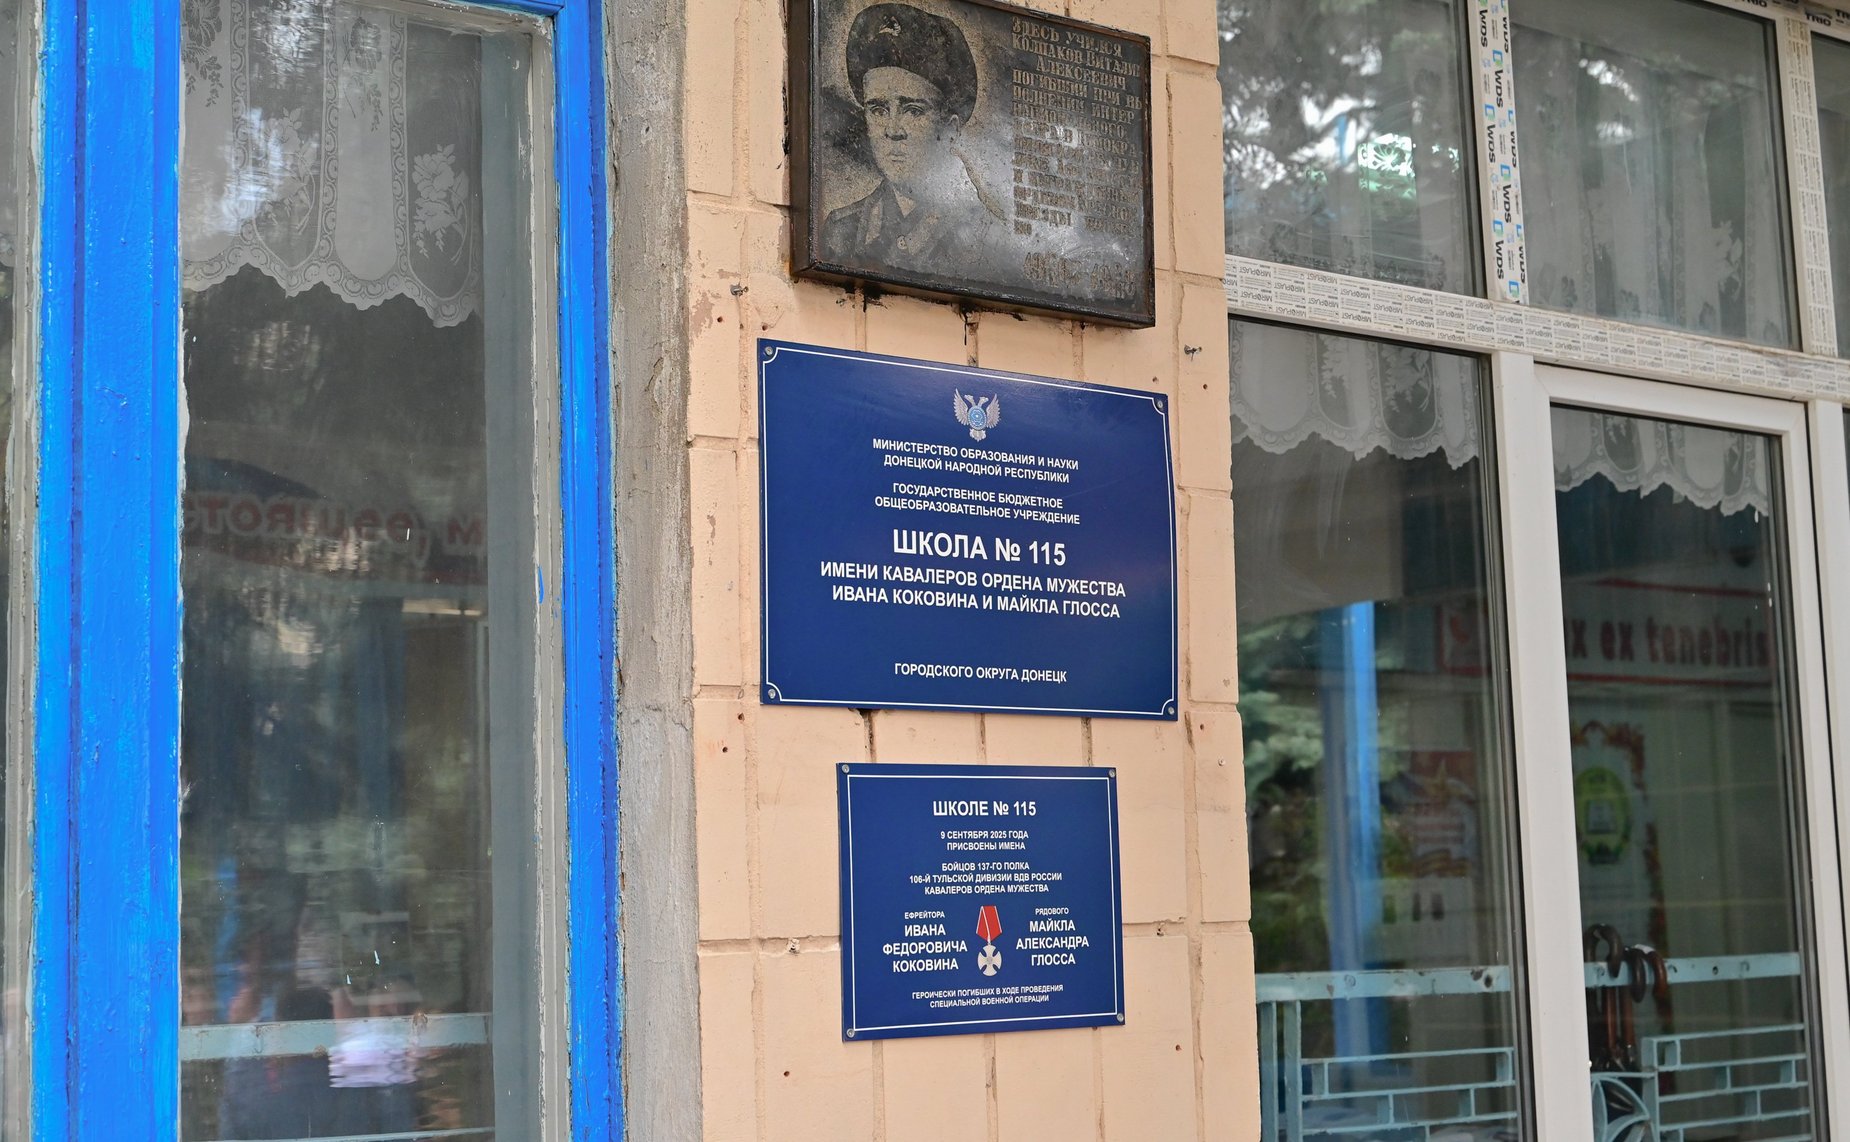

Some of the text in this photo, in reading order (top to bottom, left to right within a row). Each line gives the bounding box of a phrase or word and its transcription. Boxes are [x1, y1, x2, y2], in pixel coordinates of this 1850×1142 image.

[1479, 10, 1488, 48] WDS
[1495, 69, 1503, 108] WDS
[1487, 124, 1495, 163] WDS
[1503, 185, 1511, 223] WDS
[1495, 241, 1504, 280] WDS
[873, 438, 1078, 470] МИНИСТЕРСТВО ОБРАЗОВАНИЯ И НАУКИ
[884, 455, 1069, 483] ДОНЕЦКОЙ НАРОДНОЙ РЕСПУБЛИКИ
[893, 483, 1063, 508] ГОСУДАРСТВЕННОЕ БЮДЖЕТНОЕ
[875, 496, 1080, 524] ОБЩЕОБРАЗОВАТЕЛЬНОЕ УЧРЕЖДЕНИЕ
[894, 529, 1066, 566] ШКОЛА № 115
[821, 561, 1126, 597] ИМЕНИ КАВАЛЕРОВ ОРДЕНА МУЖЕСТВА
[833, 585, 1120, 618] ИВАНА КОКОВИНА И МАЙКЛА ГЛОССА
[895, 663, 1067, 684] ГОРОДСКОГО ОКРУГА ДОНЕЦК
[933, 801, 1036, 816] ШКОЛЕ № 115
[941, 830, 1029, 840] 9 СЕНТЯБРЯ 2025 ГОДА
[947, 842, 1025, 850] ПРИСВОЕНЫ ИМЕНА
[942, 861, 1030, 872] БОЙЦОВ 137-ГО ПОЛКА
[910, 873, 1062, 883] 106-Й ТУЛЬСКОЙ ДИВИЗИИ ВДВ РОССИИ
[925, 884, 1049, 895] КАВАЛЕРОВ ОРДЕНА МУЖЕСТВА
[905, 910, 945, 919] ЕФРЕЙТОРА
[1035, 907, 1069, 916] РЯДОВОГО
[905, 924, 946, 937] ИВАНА
[1030, 918, 1075, 932] МАЙКЛА
[883, 940, 968, 957] ФЕДОРОВИЧА
[1016, 936, 1089, 950] АЛЕКСАНДРА
[893, 958, 959, 972] КОКОВИНА
[1031, 953, 1076, 966] ГЛОССА
[912, 990, 956, 999] ГЕРОИЧЕСКИ
[957, 988, 995, 997] ПОГИБШИХ
[1002, 987, 1019, 995] ХОДЕ
[1021, 984, 1063, 993] ПРОВЕДЕНИЯ
[930, 995, 1049, 1008] СПЕЦИАЛЬНОЙ ВОЕННОЙ ОПЕРАЦИИ
